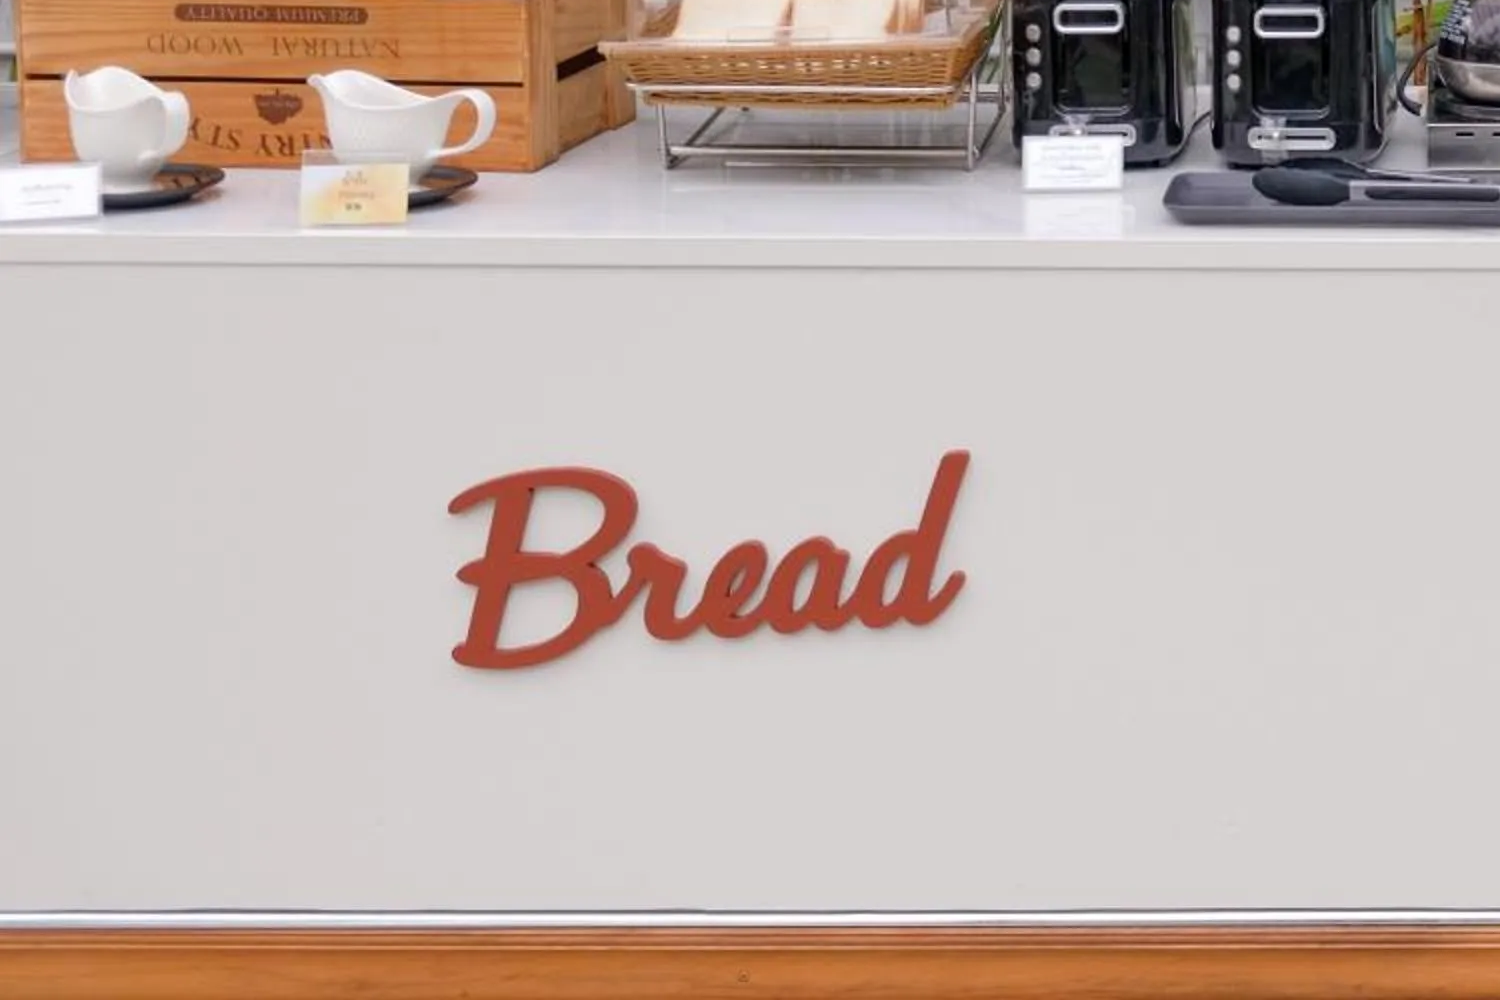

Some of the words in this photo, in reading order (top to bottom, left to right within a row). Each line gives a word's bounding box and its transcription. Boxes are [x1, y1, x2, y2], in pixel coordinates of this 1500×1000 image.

[185, 5, 268, 22] QUALITY
[277, 5, 363, 24] PREMIUM
[145, 31, 246, 52] WOOD
[270, 34, 402, 59] NATURAL
[447, 449, 971, 670] Bread
